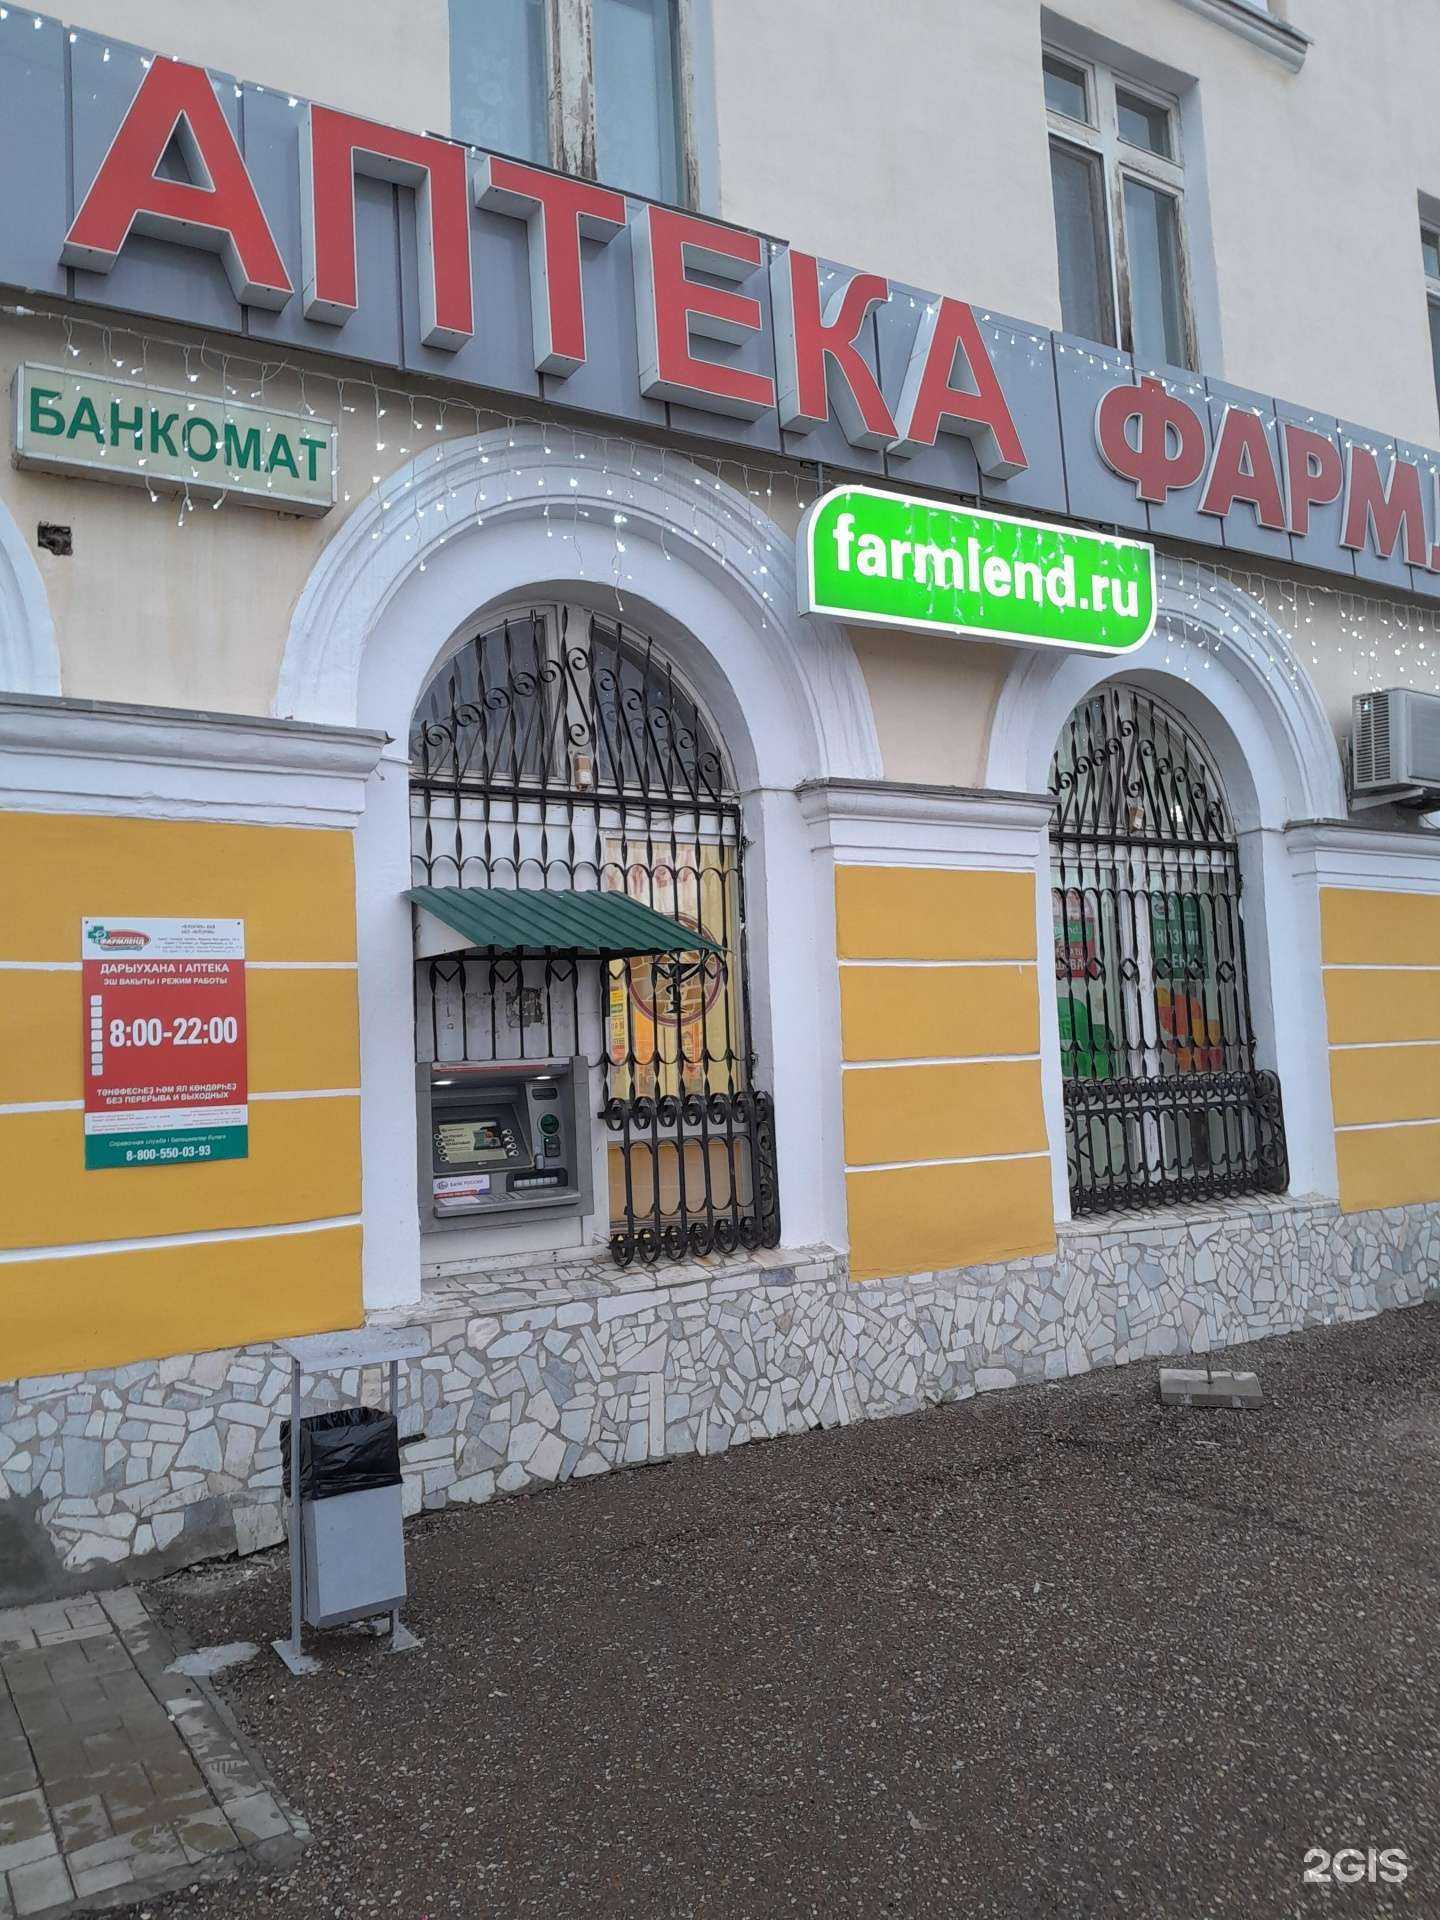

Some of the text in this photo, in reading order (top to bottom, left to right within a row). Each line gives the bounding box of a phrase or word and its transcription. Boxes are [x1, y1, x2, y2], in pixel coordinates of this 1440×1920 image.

[62, 55, 1440, 573] АПТЕКА ФАРМ
[30, 387, 327, 482] БАНКОМАТ
[832, 513, 1139, 618] farmlend.ru
[101, 963, 230, 975] ДАРЫУХАНА АПТЕКА
[161, 977, 192, 985] РЕЖИМ
[193, 976, 228, 985] РАБОТЫ
[109, 1016, 238, 1048] 8:00-22:00
[106, 1096, 123, 1105] БЕЗ
[125, 1094, 172, 1103] ПЕРЕРЫВА
[181, 1091, 229, 1101] ВЫХОДНЫХ
[126, 1144, 212, 1162] 8-800-550-03-93
